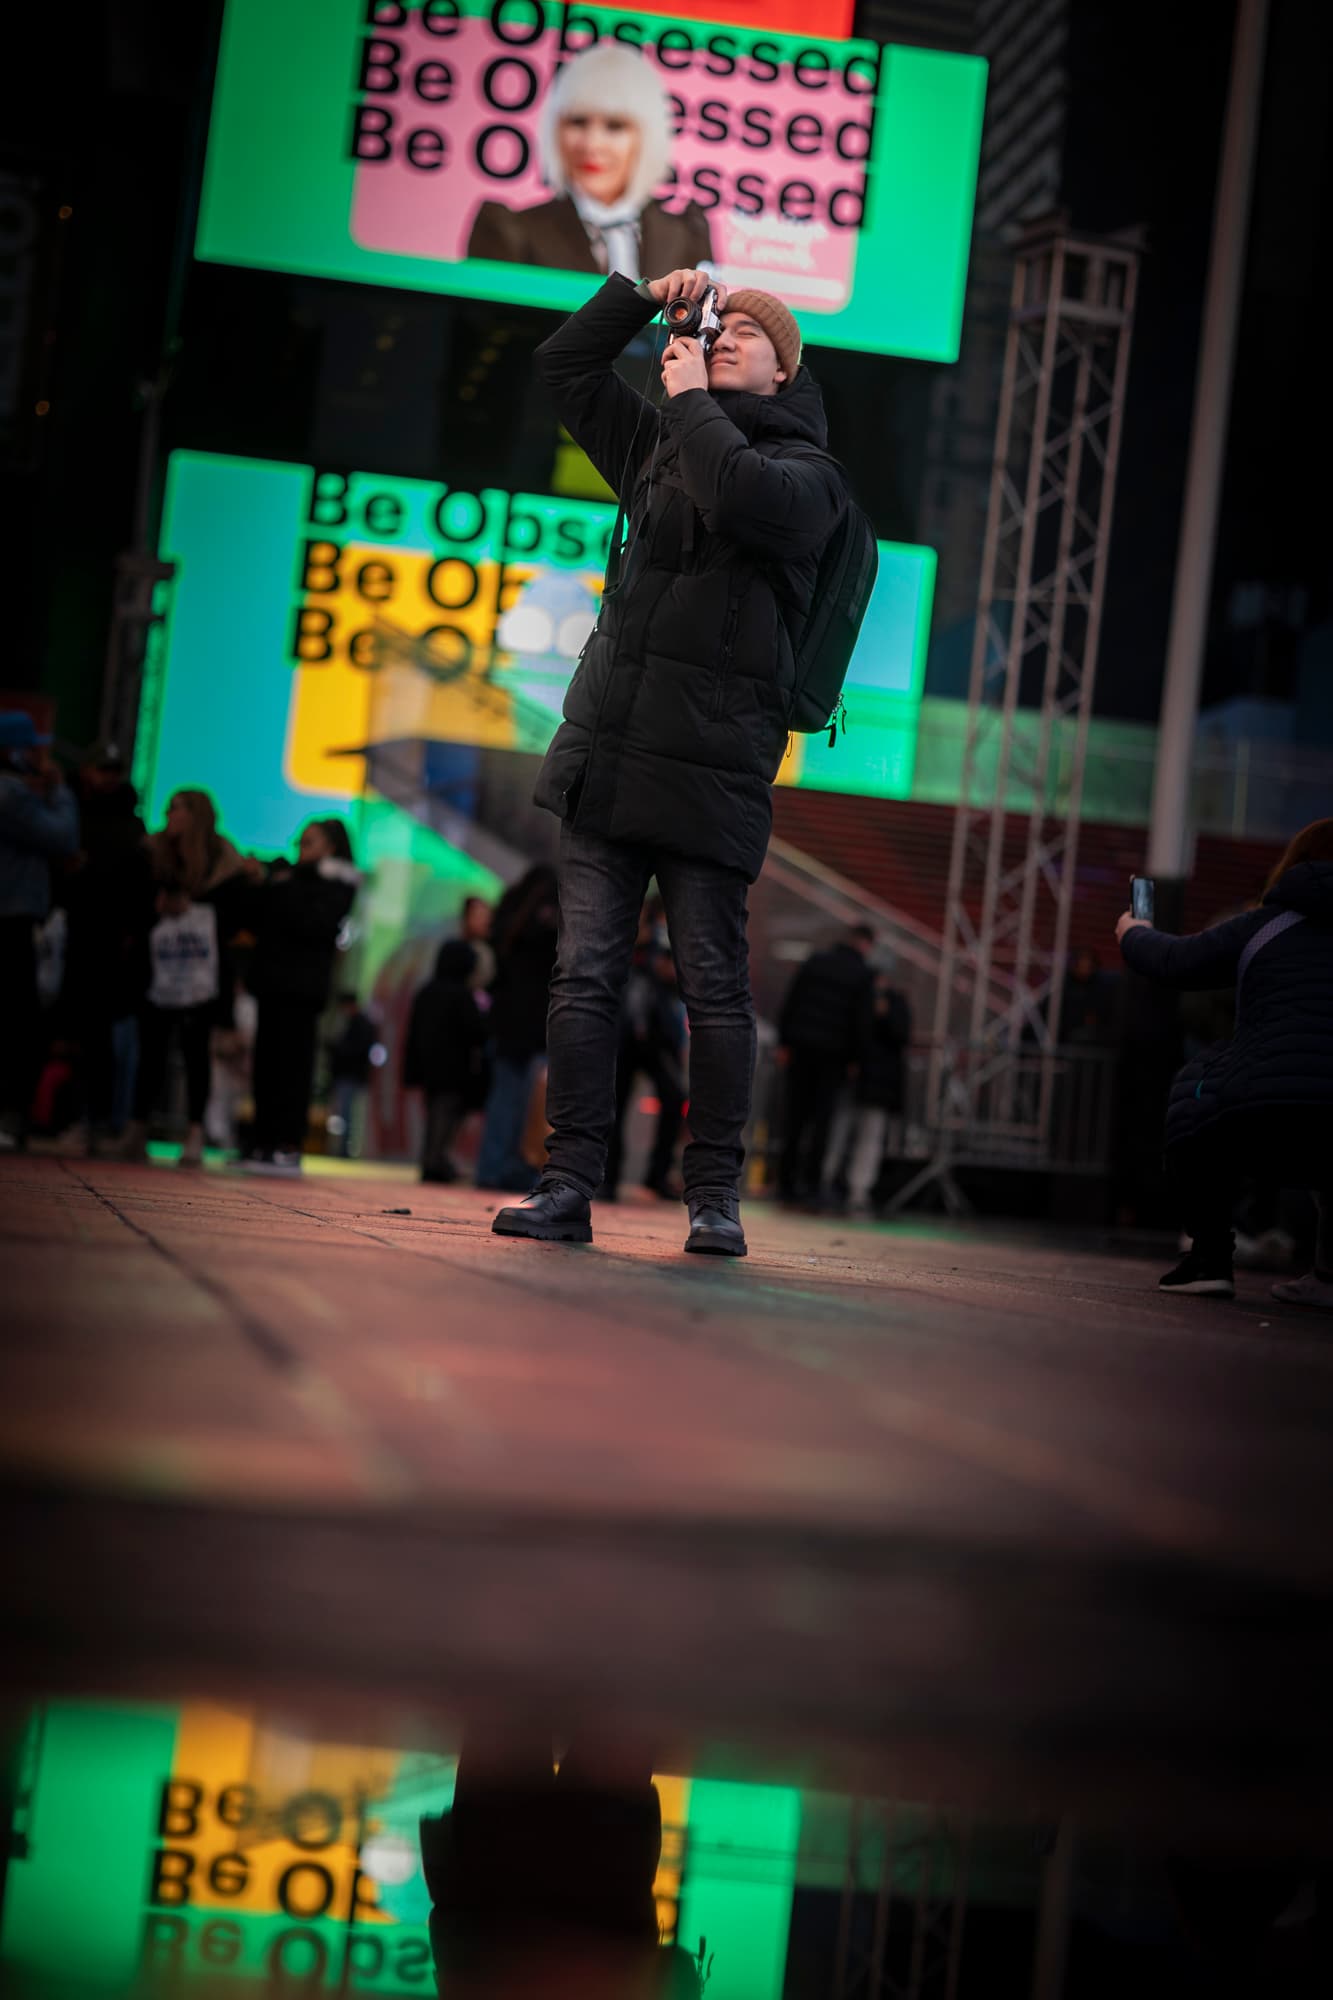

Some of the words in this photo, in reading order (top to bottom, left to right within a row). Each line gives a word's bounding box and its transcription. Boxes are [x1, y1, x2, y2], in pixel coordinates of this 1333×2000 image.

[359, 38, 453, 103] Be
[351, 105, 445, 170] Be
[308, 472, 403, 537] Be
[300, 540, 394, 602] Be
